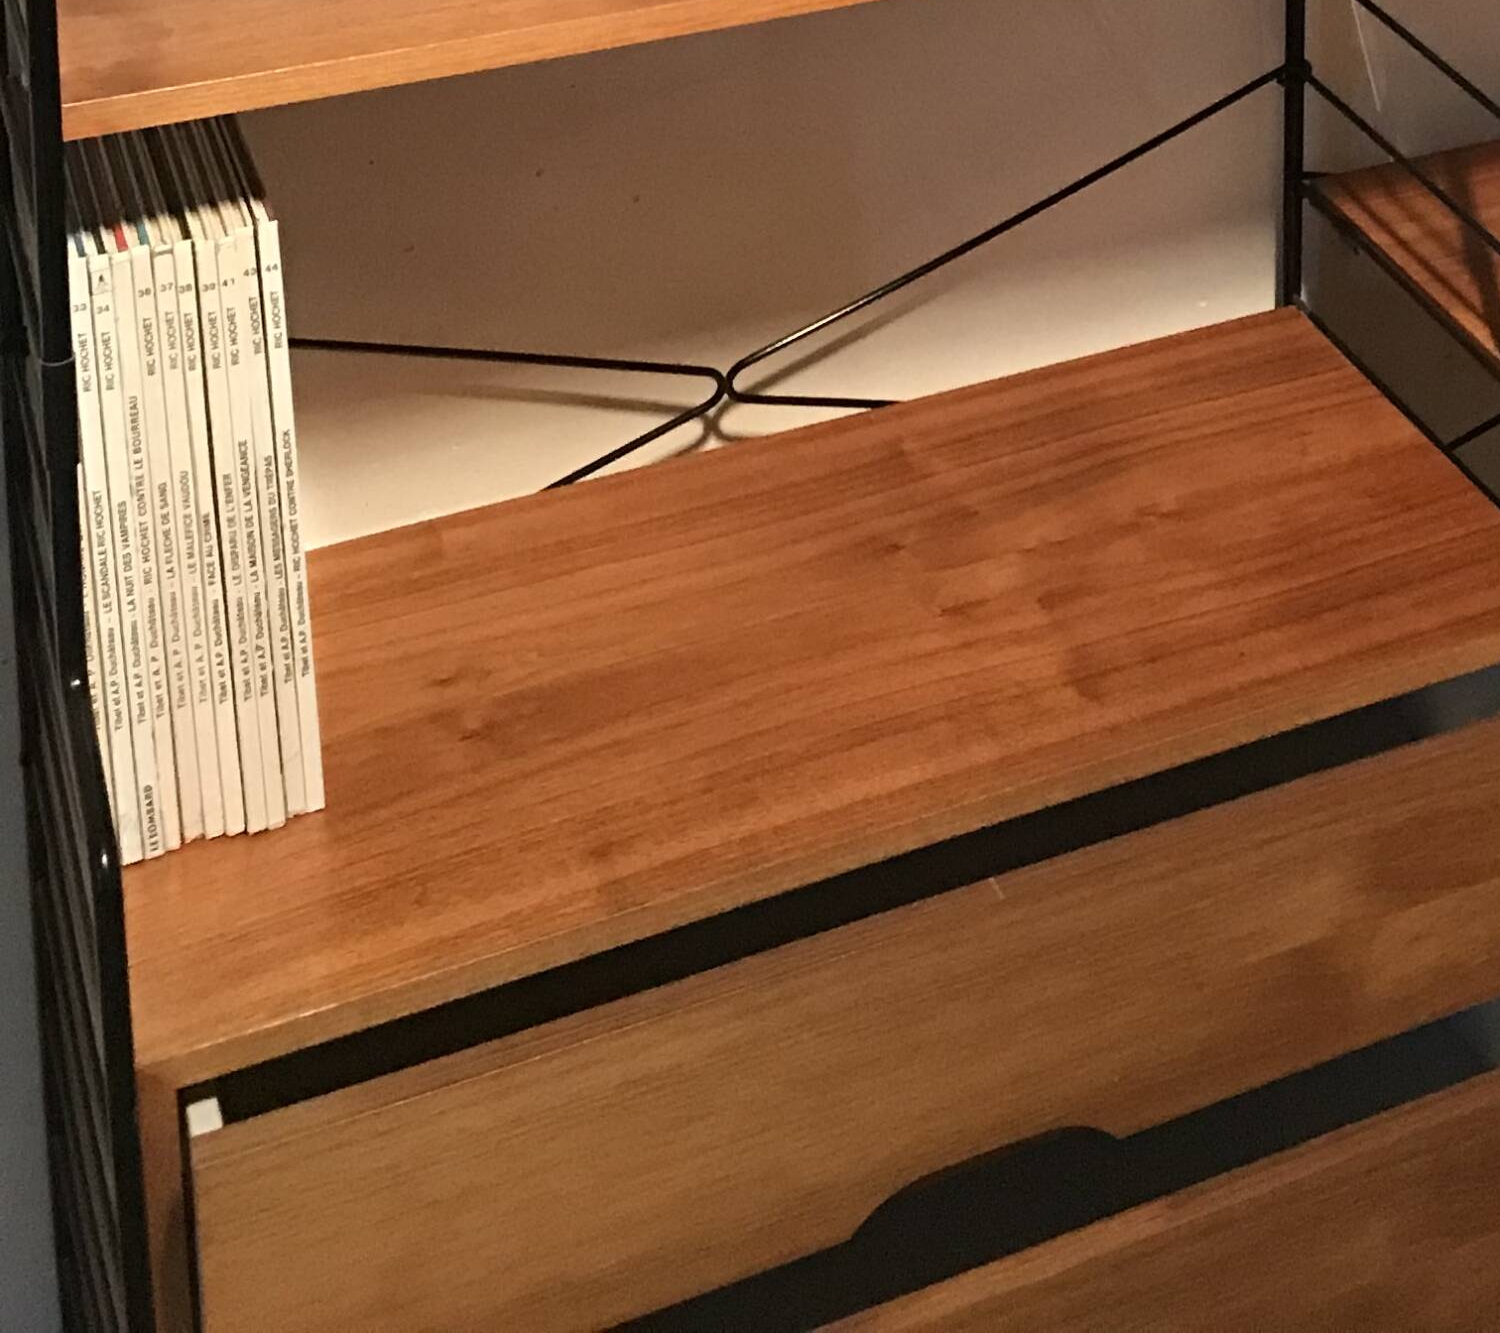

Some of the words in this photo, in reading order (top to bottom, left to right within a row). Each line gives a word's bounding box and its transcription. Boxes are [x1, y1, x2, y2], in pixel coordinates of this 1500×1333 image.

[249, 296, 261, 335] HOCHET
[165, 311, 177, 350] HOCHET
[208, 311, 220, 349] HOCHET
[101, 331, 113, 370] HOCHET
[253, 337, 263, 354] RIC
[168, 352, 179, 370] RIC
[211, 351, 222, 369] RIC
[105, 372, 115, 391] RIC
[129, 395, 143, 454] BOURREAU
[134, 458, 144, 470] LE
[135, 474, 147, 517] CONTRE
[158, 482, 169, 509] SANG
[179, 470, 192, 509] VAUDOU
[266, 492, 276, 505] DU
[285, 479, 298, 516] CONTRE
[92, 489, 105, 529] HOCHET
[243, 500, 253, 511] LA
[118, 500, 131, 549] VAMPIRES
[161, 511, 170, 525] DE
[226, 515, 236, 528] DE
[244, 515, 255, 528] DE
[203, 512, 212, 543] CRIME
[288, 518, 301, 554] HOCHET
[95, 529, 106, 547] RIC
[138, 520, 153, 563] HOCHET
[204, 546, 213, 557] AU
[244, 530, 258, 567] MAISON
[121, 552, 132, 572] DES
[187, 562, 197, 574] LE
[291, 556, 302, 572] RIC
[98, 548, 111, 599] SCANDALE
[143, 567, 153, 585] RIC
[166, 567, 176, 579] LA
[205, 561, 217, 585] FACE
[232, 573, 242, 585] LE
[249, 570, 259, 583] LA
[274, 563, 284, 580] LES
[123, 575, 135, 597] NUIT
[102, 601, 113, 614] LE
[127, 598, 137, 612] LA
